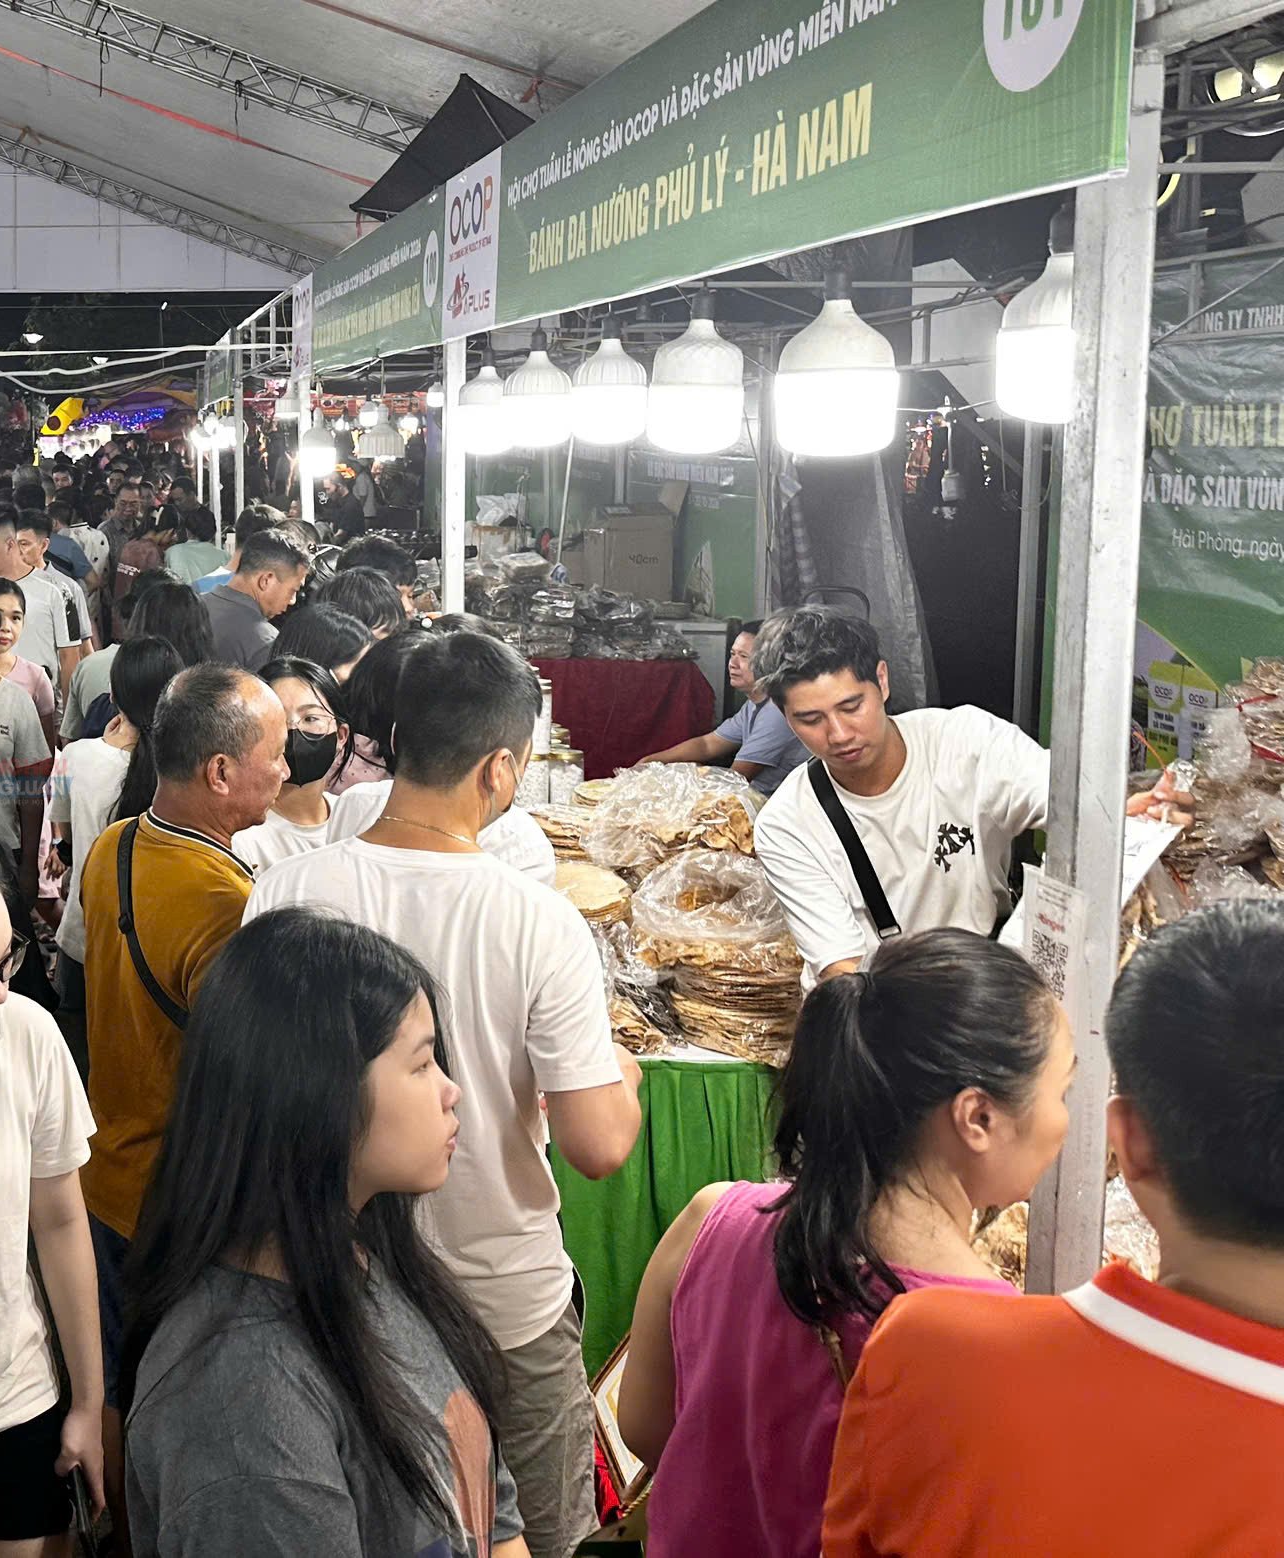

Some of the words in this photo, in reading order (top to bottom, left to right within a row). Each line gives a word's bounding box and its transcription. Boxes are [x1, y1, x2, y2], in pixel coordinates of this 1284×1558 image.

[572, 137, 600, 173] NÔNG
[602, 119, 623, 159] SẢN
[624, 103, 658, 146] OCOP
[660, 85, 678, 127] VÀ
[680, 71, 710, 120] ĐẶC
[713, 51, 744, 100] SẢN
[746, 27, 794, 83] VÙNG
[529, 217, 565, 274] BÁNH
[566, 210, 586, 262] ĐA
[590, 183, 649, 254] NƯỚNG
[654, 143, 697, 231] PHỦ
[700, 134, 729, 214] LÝ
[751, 110, 787, 197] HÀ
[796, 82, 873, 181] NAM
[450, 175, 493, 245] OCOP
[1228, 308, 1243, 330] TY
[1148, 401, 1185, 456] HỢ
[1160, 466, 1197, 511] ĐẶC
[1202, 464, 1242, 508] SẢN
[1246, 470, 1284, 511] VÙN
[1172, 528, 1195, 549] Hải
